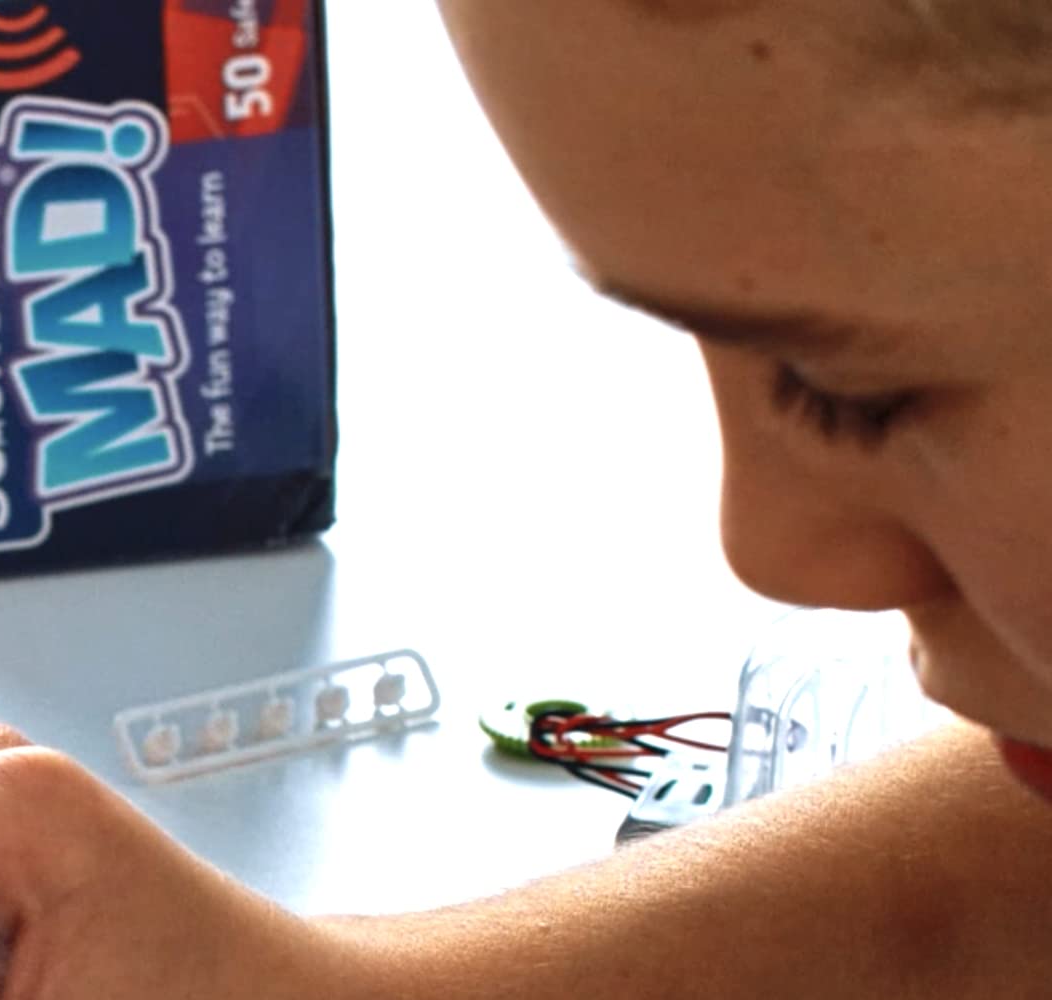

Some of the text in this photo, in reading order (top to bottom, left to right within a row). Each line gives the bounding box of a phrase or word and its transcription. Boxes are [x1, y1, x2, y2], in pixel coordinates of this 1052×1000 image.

[222, 54, 273, 121] 50
[6, 112, 176, 497] MAD!
[198, 170, 235, 455] The fun way to learn
